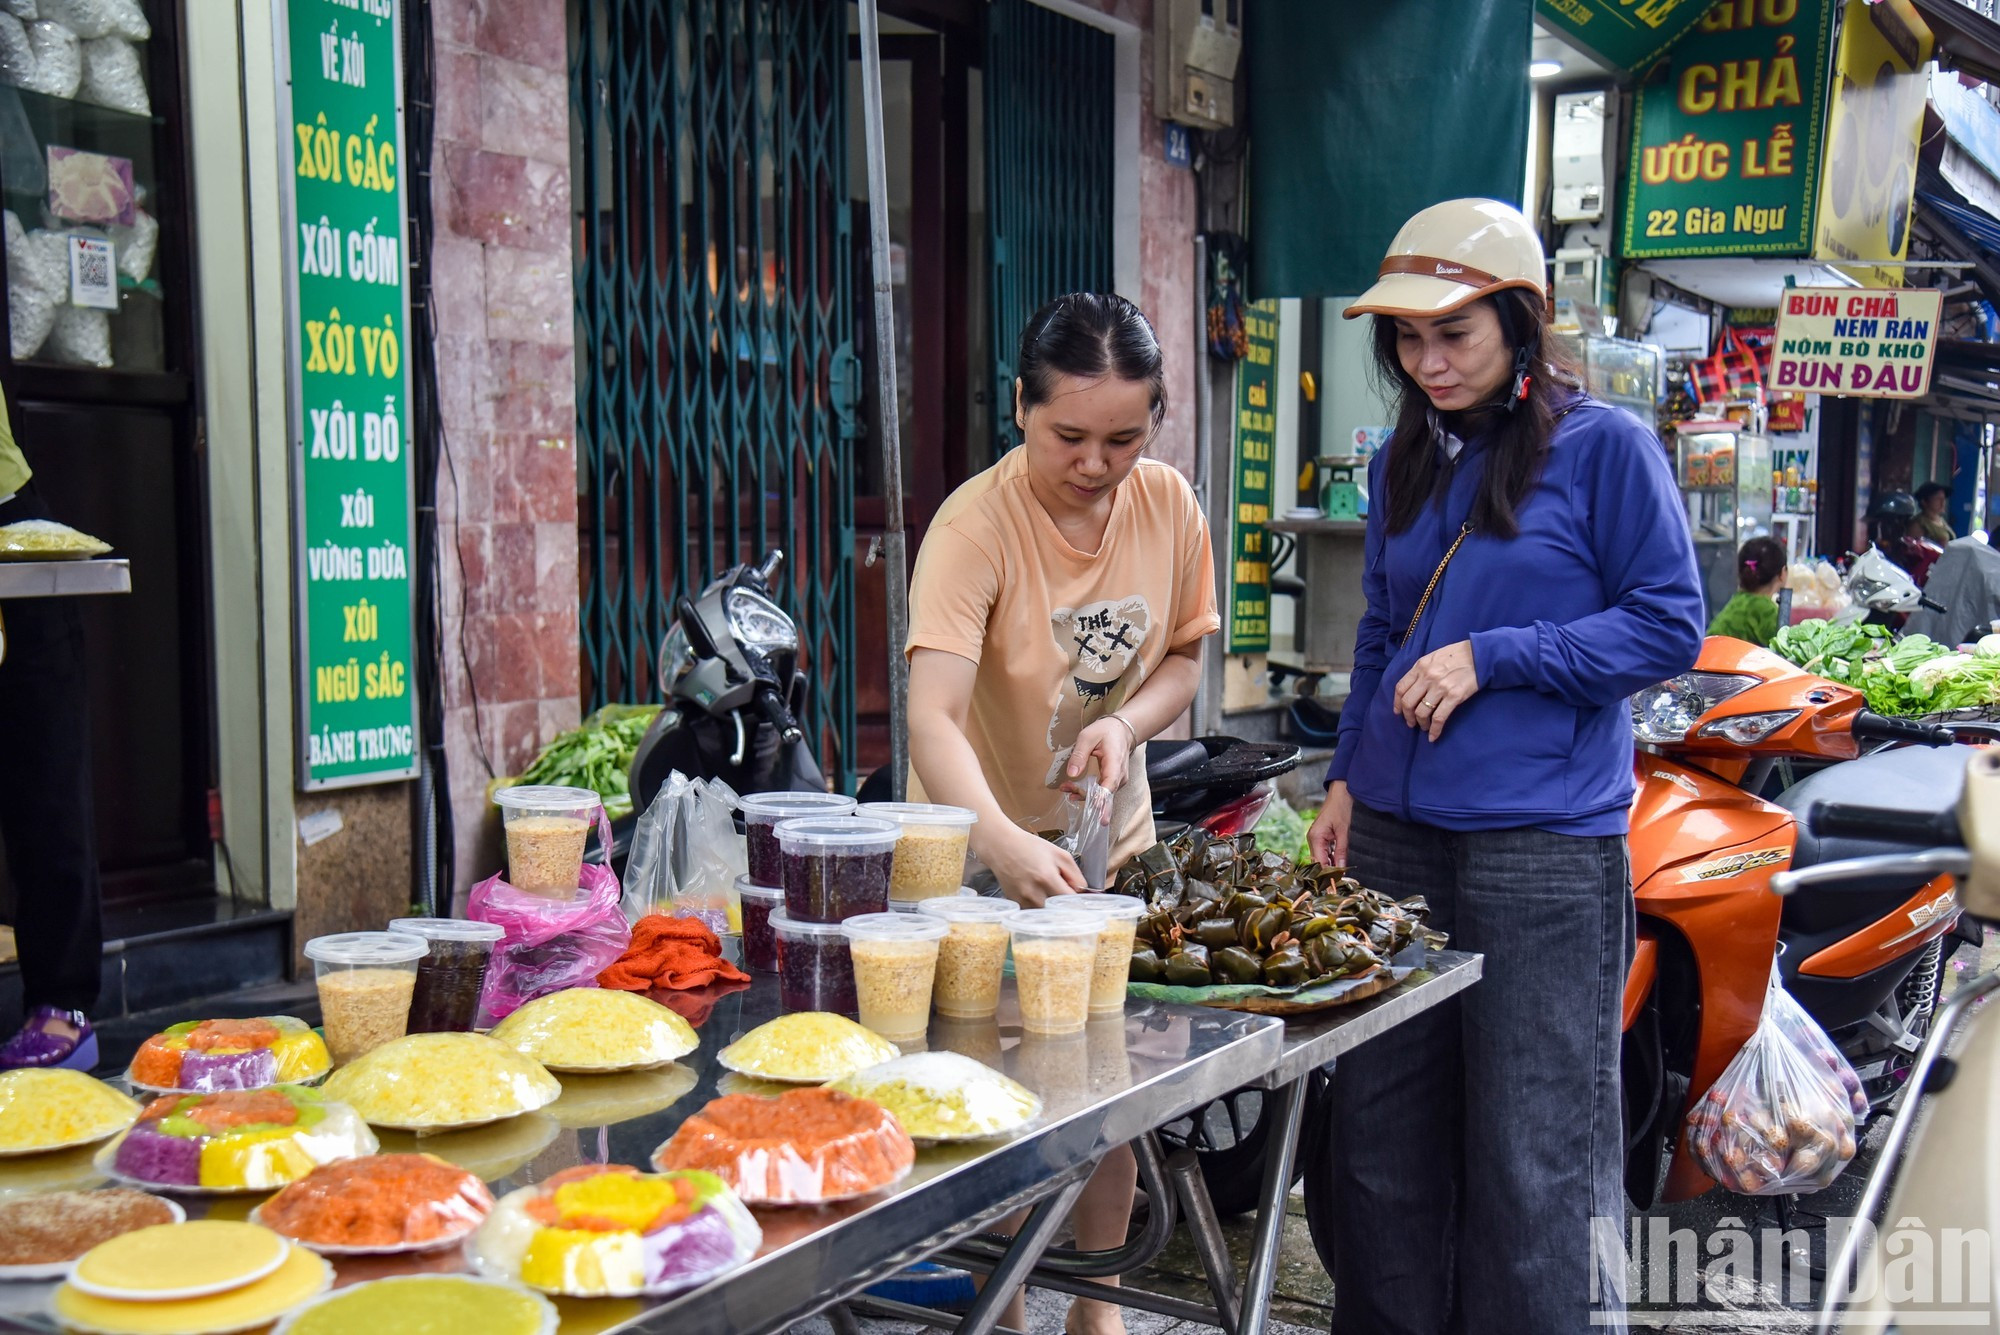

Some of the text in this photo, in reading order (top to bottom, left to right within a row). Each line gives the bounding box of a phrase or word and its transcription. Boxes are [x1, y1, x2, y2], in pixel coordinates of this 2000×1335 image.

[320, 18, 366, 88] VỀ XÔI
[1679, 34, 1801, 115] CHẢ
[296, 111, 396, 193] XÔI GẤC
[1169, 130, 1187, 160] 24
[1642, 123, 1795, 184] ƯỚC LỄ
[1645, 204, 1788, 238] 22 Gia Ngư
[301, 215, 399, 286] XÔI CỐM
[1787, 292, 1838, 317] BÚN
[305, 306, 399, 379] XÔI VÒ
[1833, 317, 1929, 340] NEM RÁN
[1839, 341, 1870, 357] BÒ
[1878, 341, 1925, 359] KHÔ
[310, 394, 399, 463] XÔI ĐỖ
[340, 487, 375, 528] XÔI
[308, 538, 407, 582] VỪNG DỪA
[343, 597, 378, 642] XÔI
[1078, 608, 1111, 632] THE
[316, 649, 405, 704] NGŨ SẮC
[310, 723, 356, 767] BÁNH
